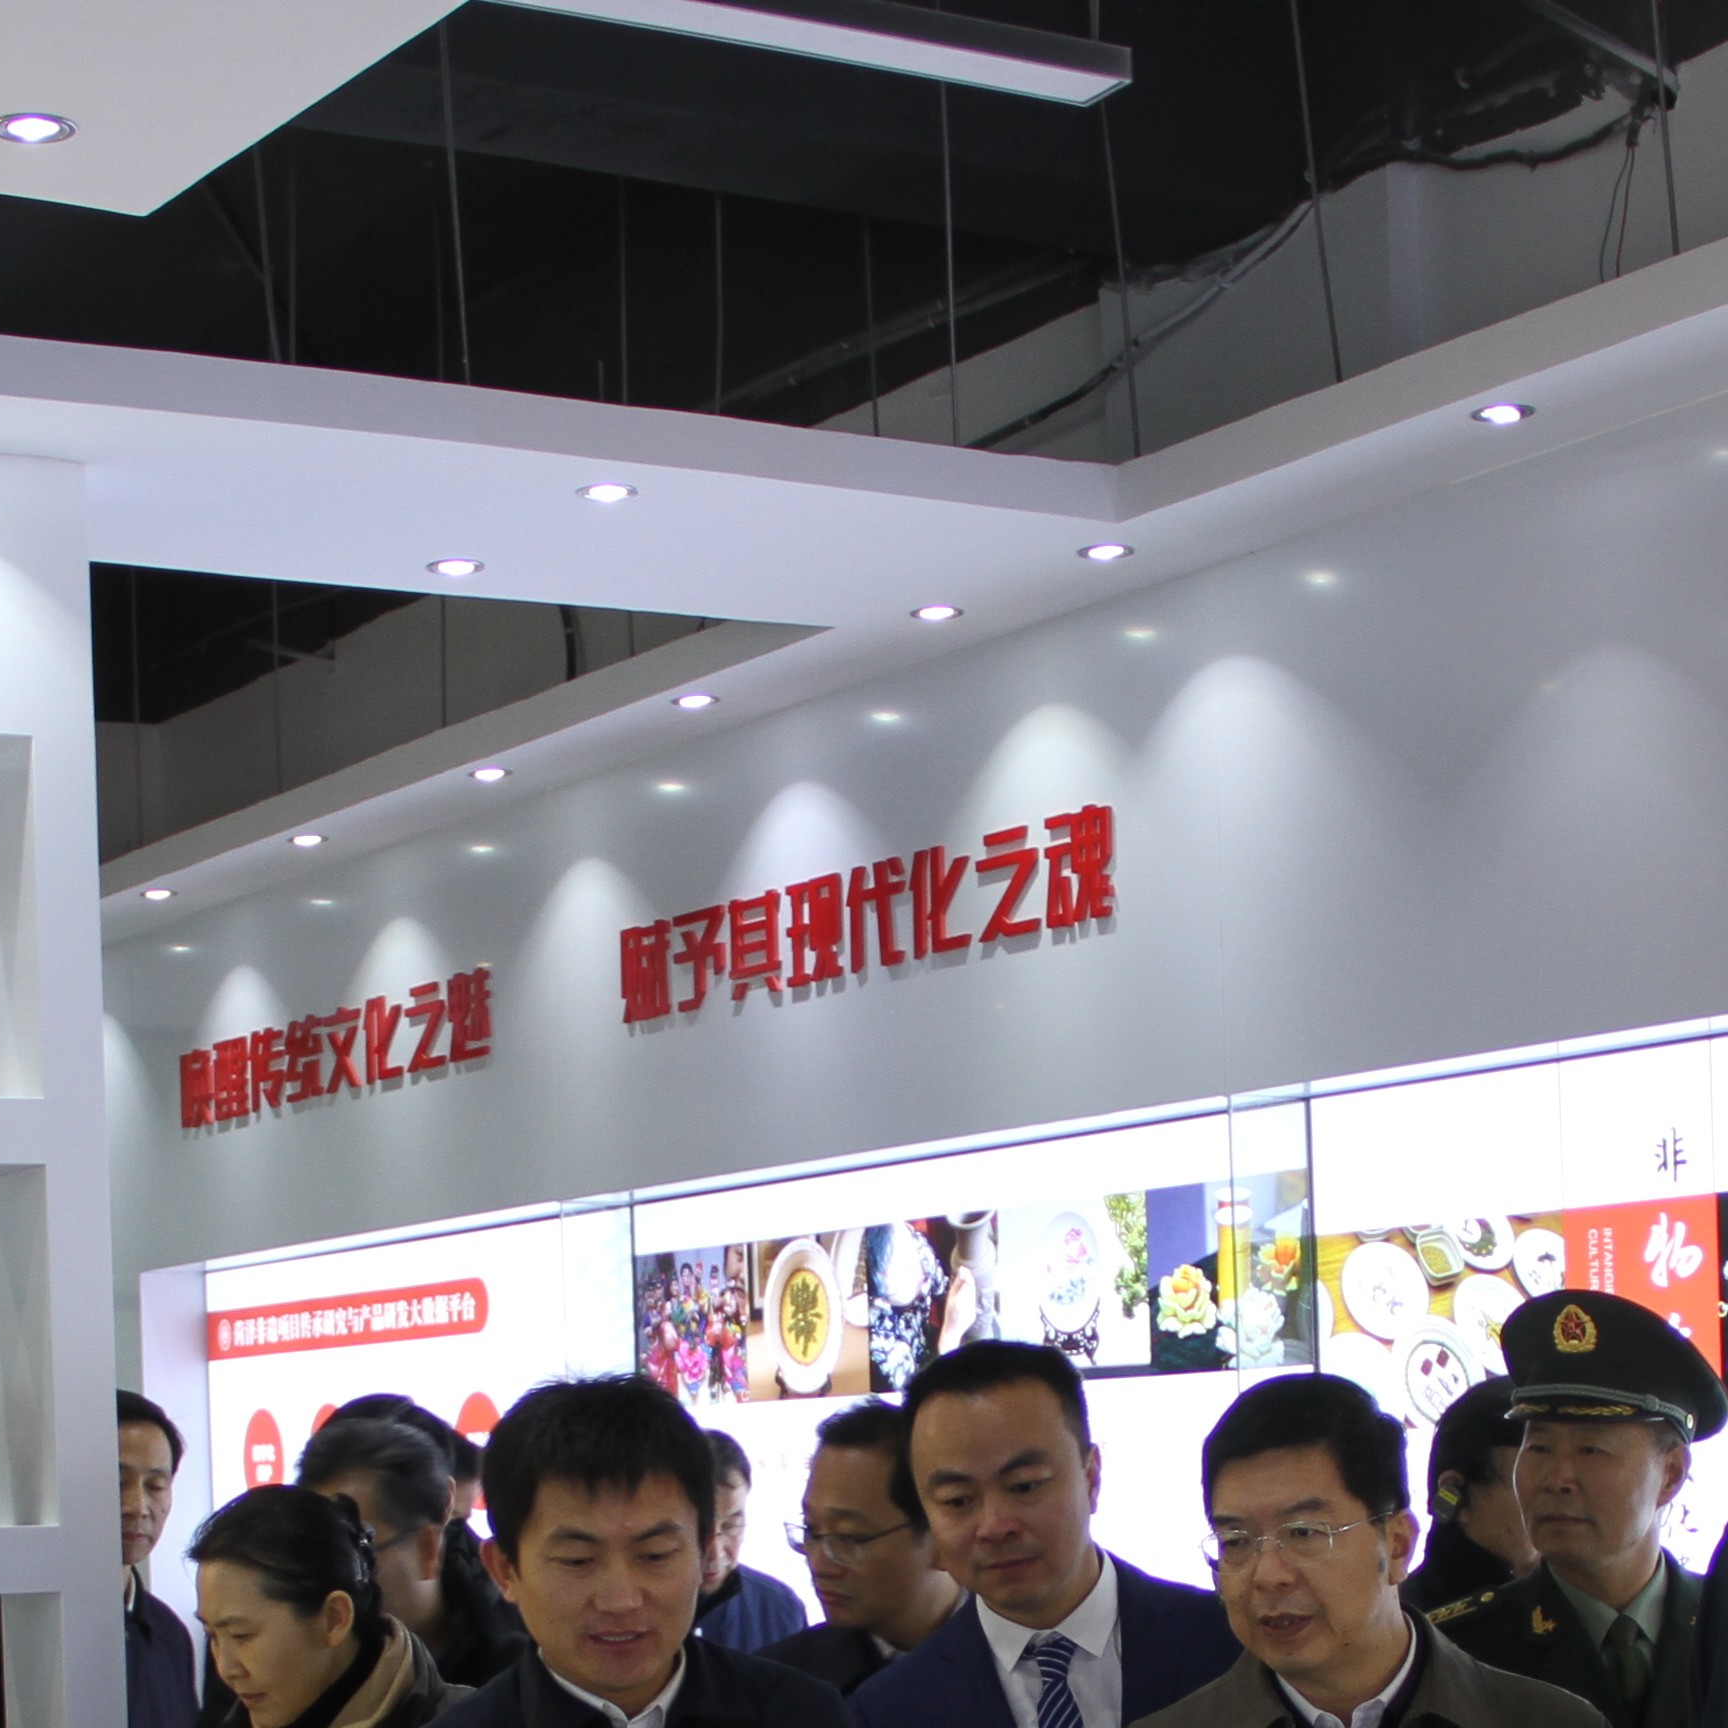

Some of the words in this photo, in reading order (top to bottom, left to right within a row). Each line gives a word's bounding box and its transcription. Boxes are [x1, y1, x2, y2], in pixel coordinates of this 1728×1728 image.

[621, 804, 1115, 1023] 赋予其现代化之魂
[180, 968, 491, 1128] 唤醒传统文化之魅
